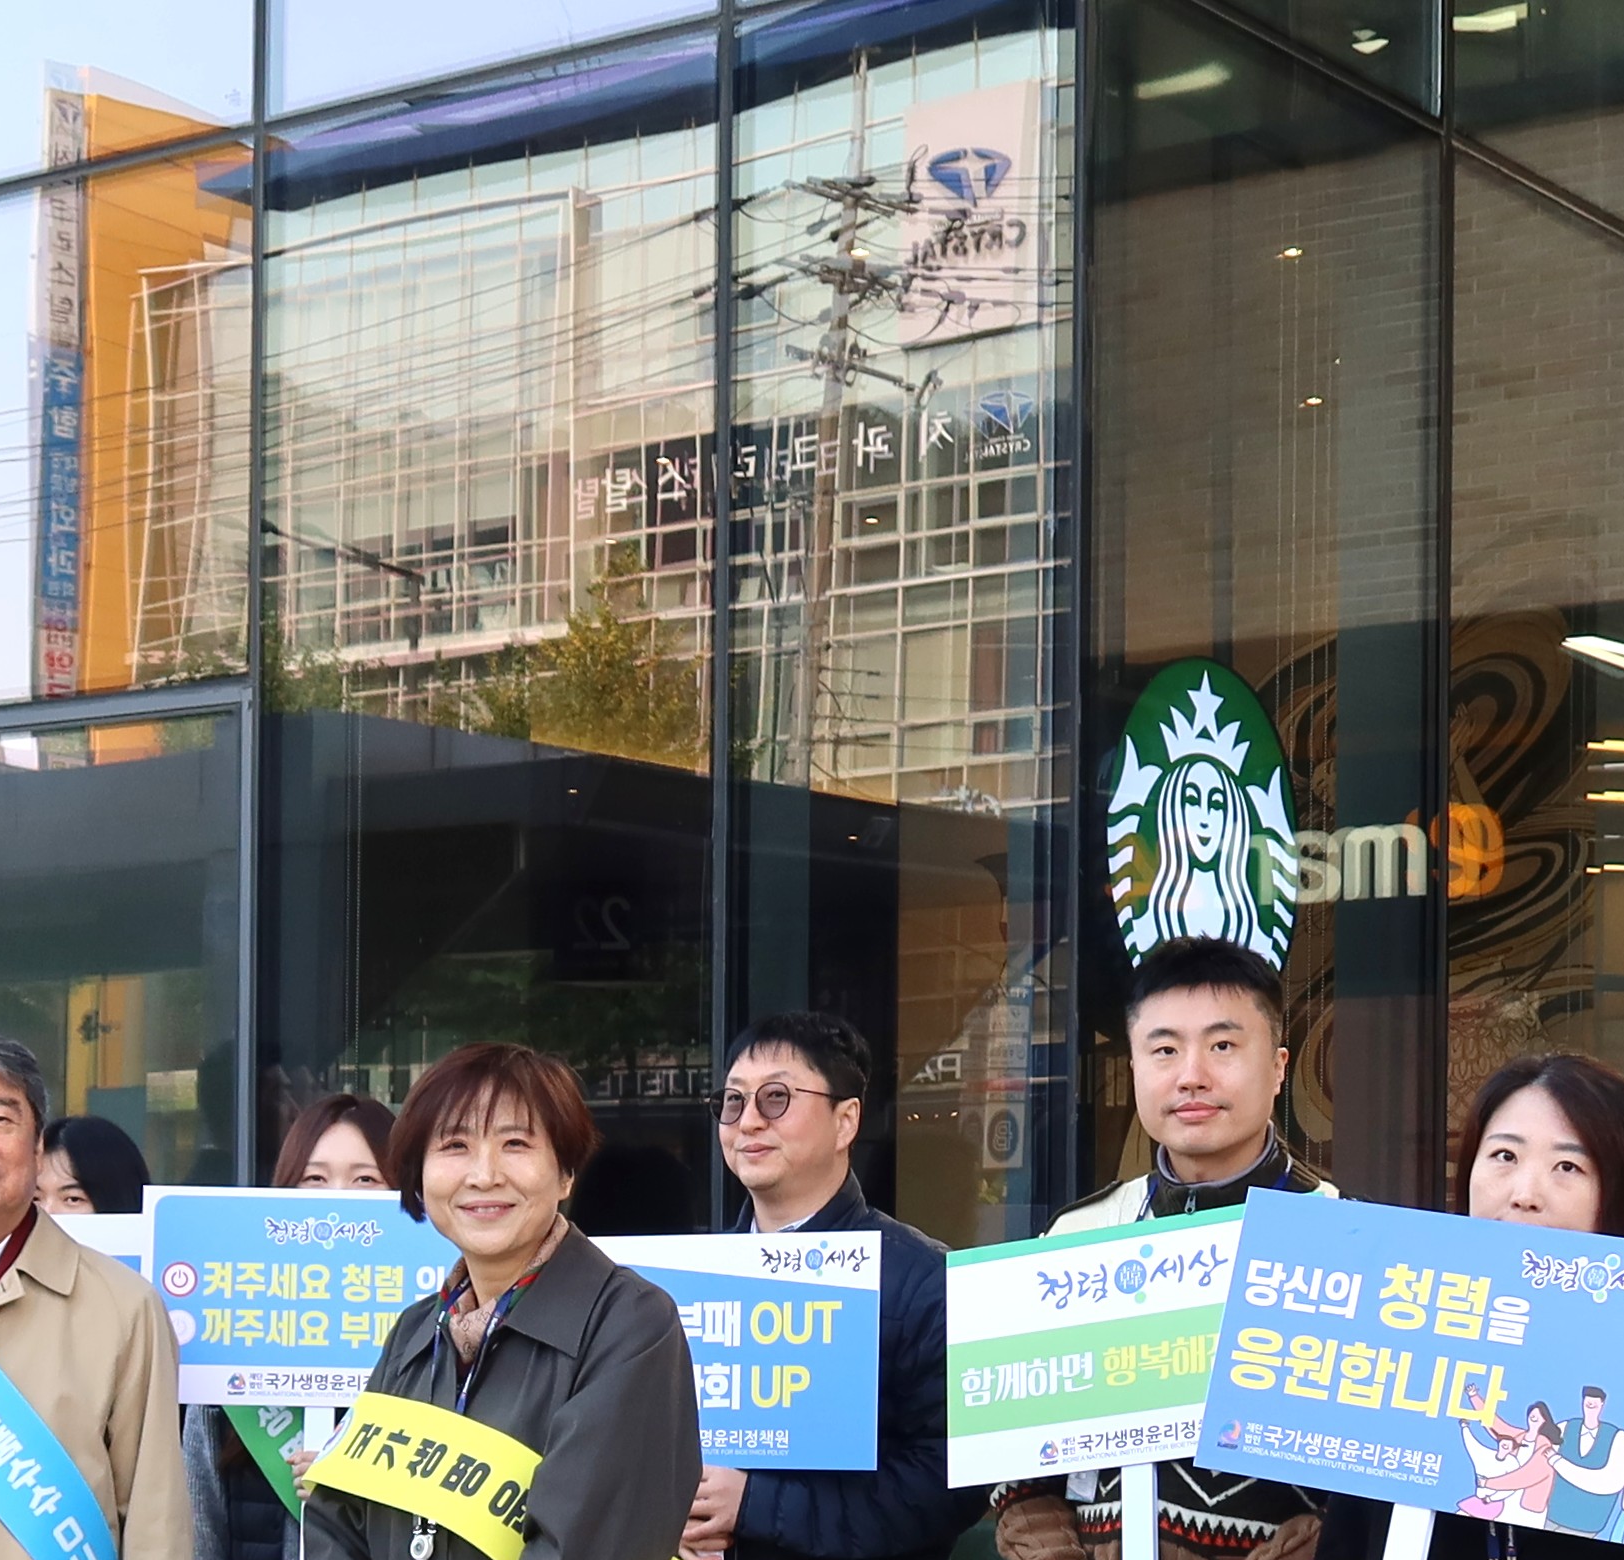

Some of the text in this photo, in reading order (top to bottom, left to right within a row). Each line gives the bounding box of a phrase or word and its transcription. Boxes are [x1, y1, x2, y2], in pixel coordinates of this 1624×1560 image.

[202, 1260, 331, 1302] 켜주세요
[340, 1263, 405, 1303] 청렴
[1245, 1258, 1533, 1346] 당신의 청렴을
[200, 1307, 329, 1348] 꺼주세요
[749, 1300, 843, 1347] OUT
[749, 1364, 812, 1410] UP
[960, 1349, 1095, 1408] 함께하면
[1228, 1326, 1509, 1427] 응원합니다
[1242, 1445, 1439, 1487] KOREA NATIONAL INSTITUTE FOR BIOETHICS POLICY
[1263, 1425, 1443, 1477] 국가생명윤리정책원
